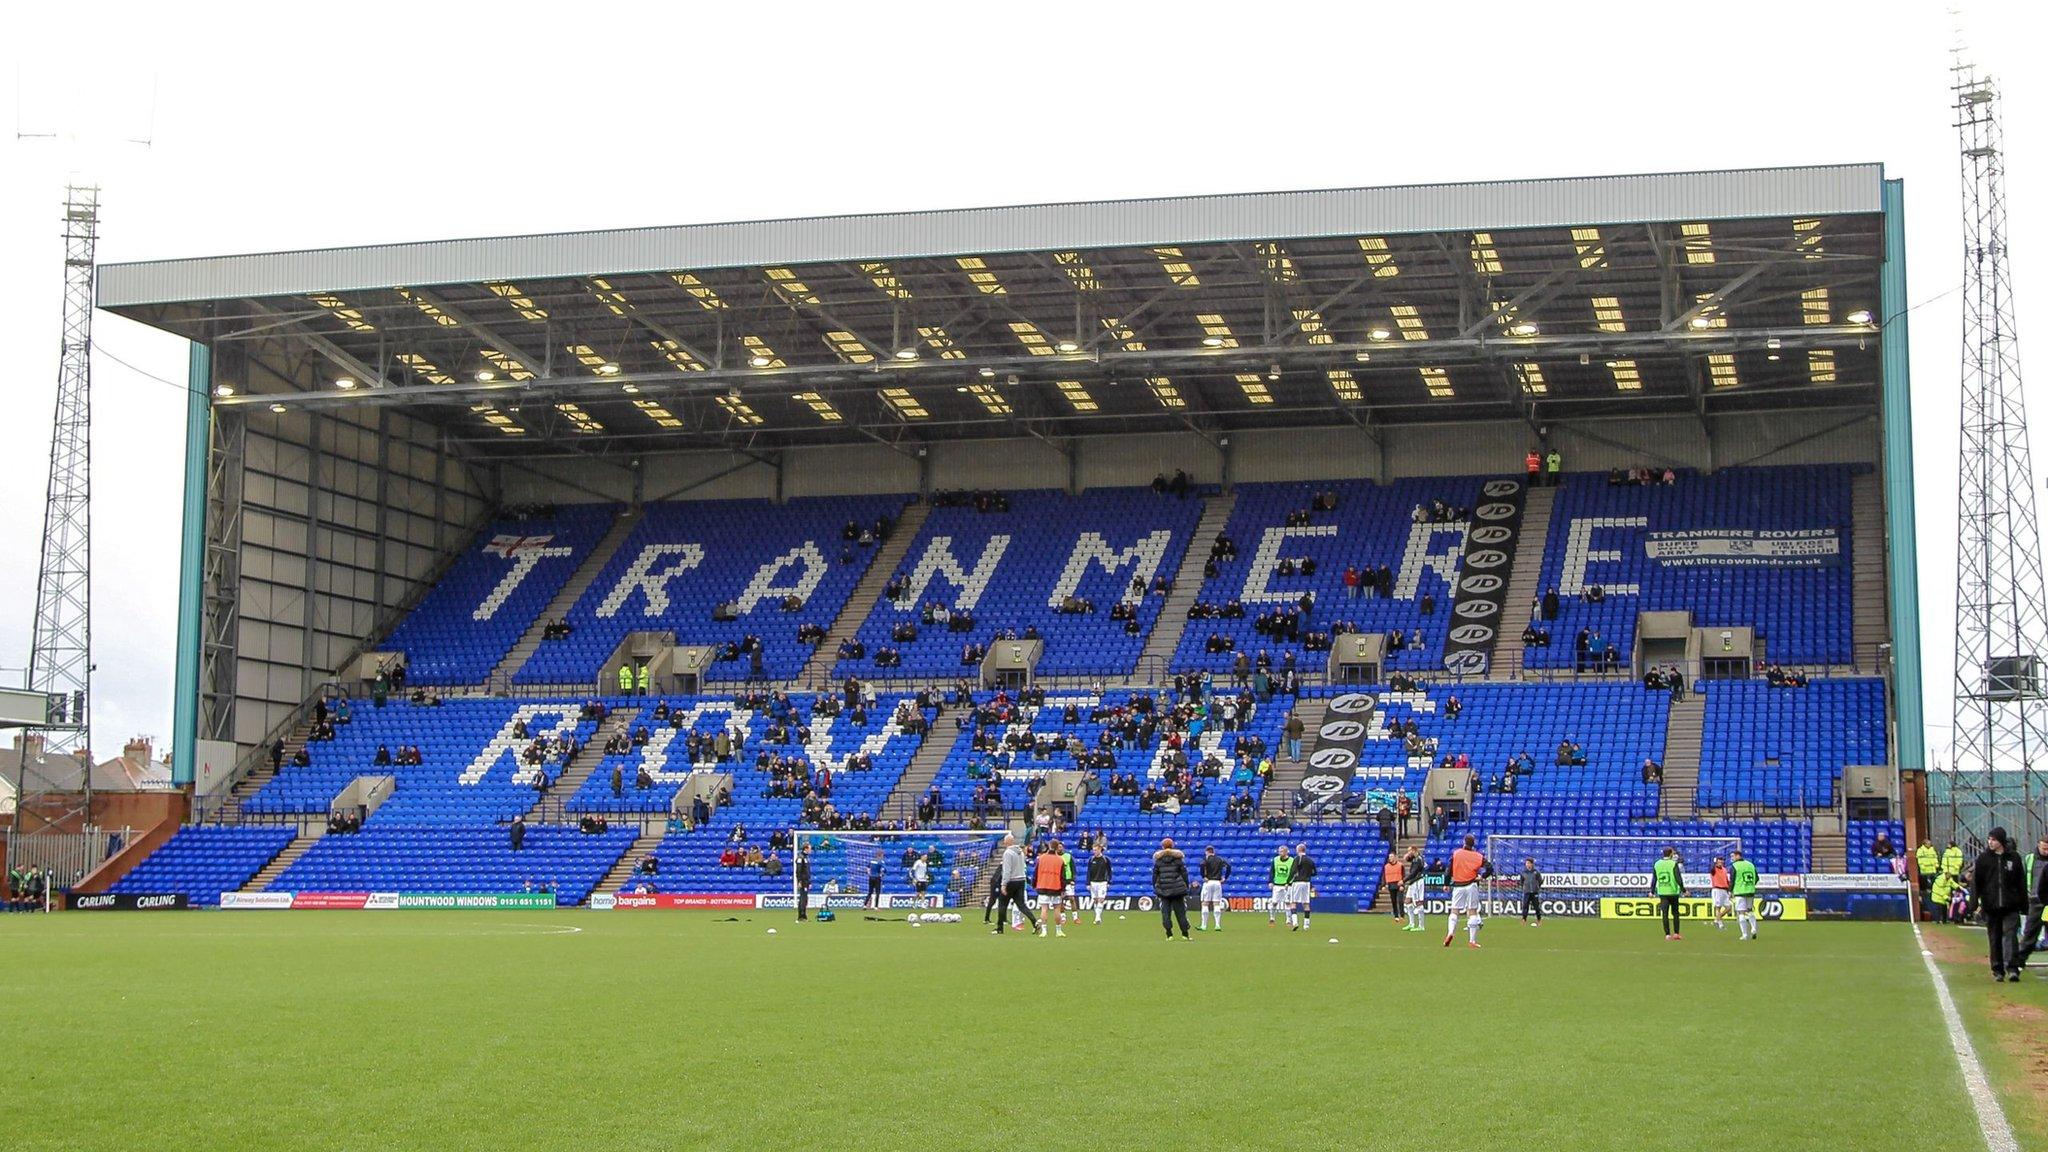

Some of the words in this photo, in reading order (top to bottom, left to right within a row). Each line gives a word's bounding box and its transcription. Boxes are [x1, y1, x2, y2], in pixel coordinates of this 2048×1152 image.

[1650, 529, 1753, 539] TRANMERE
[1759, 528, 1836, 539] ROVERS
[1066, 782, 1073, 791] C
[1863, 777, 1871, 786] E
[1580, 876, 1610, 886] DOG
[1613, 876, 1648, 886] FOOD
[77, 895, 116, 908] CARLING
[137, 895, 176, 908] CARLING
[400, 896, 455, 907] MOUNTWOOD
[457, 896, 498, 907] WINDOWS
[500, 898, 517, 906] 0151
[535, 898, 552, 906] 1151
[618, 895, 657, 908] bargains
[1762, 900, 1782, 916] JD
